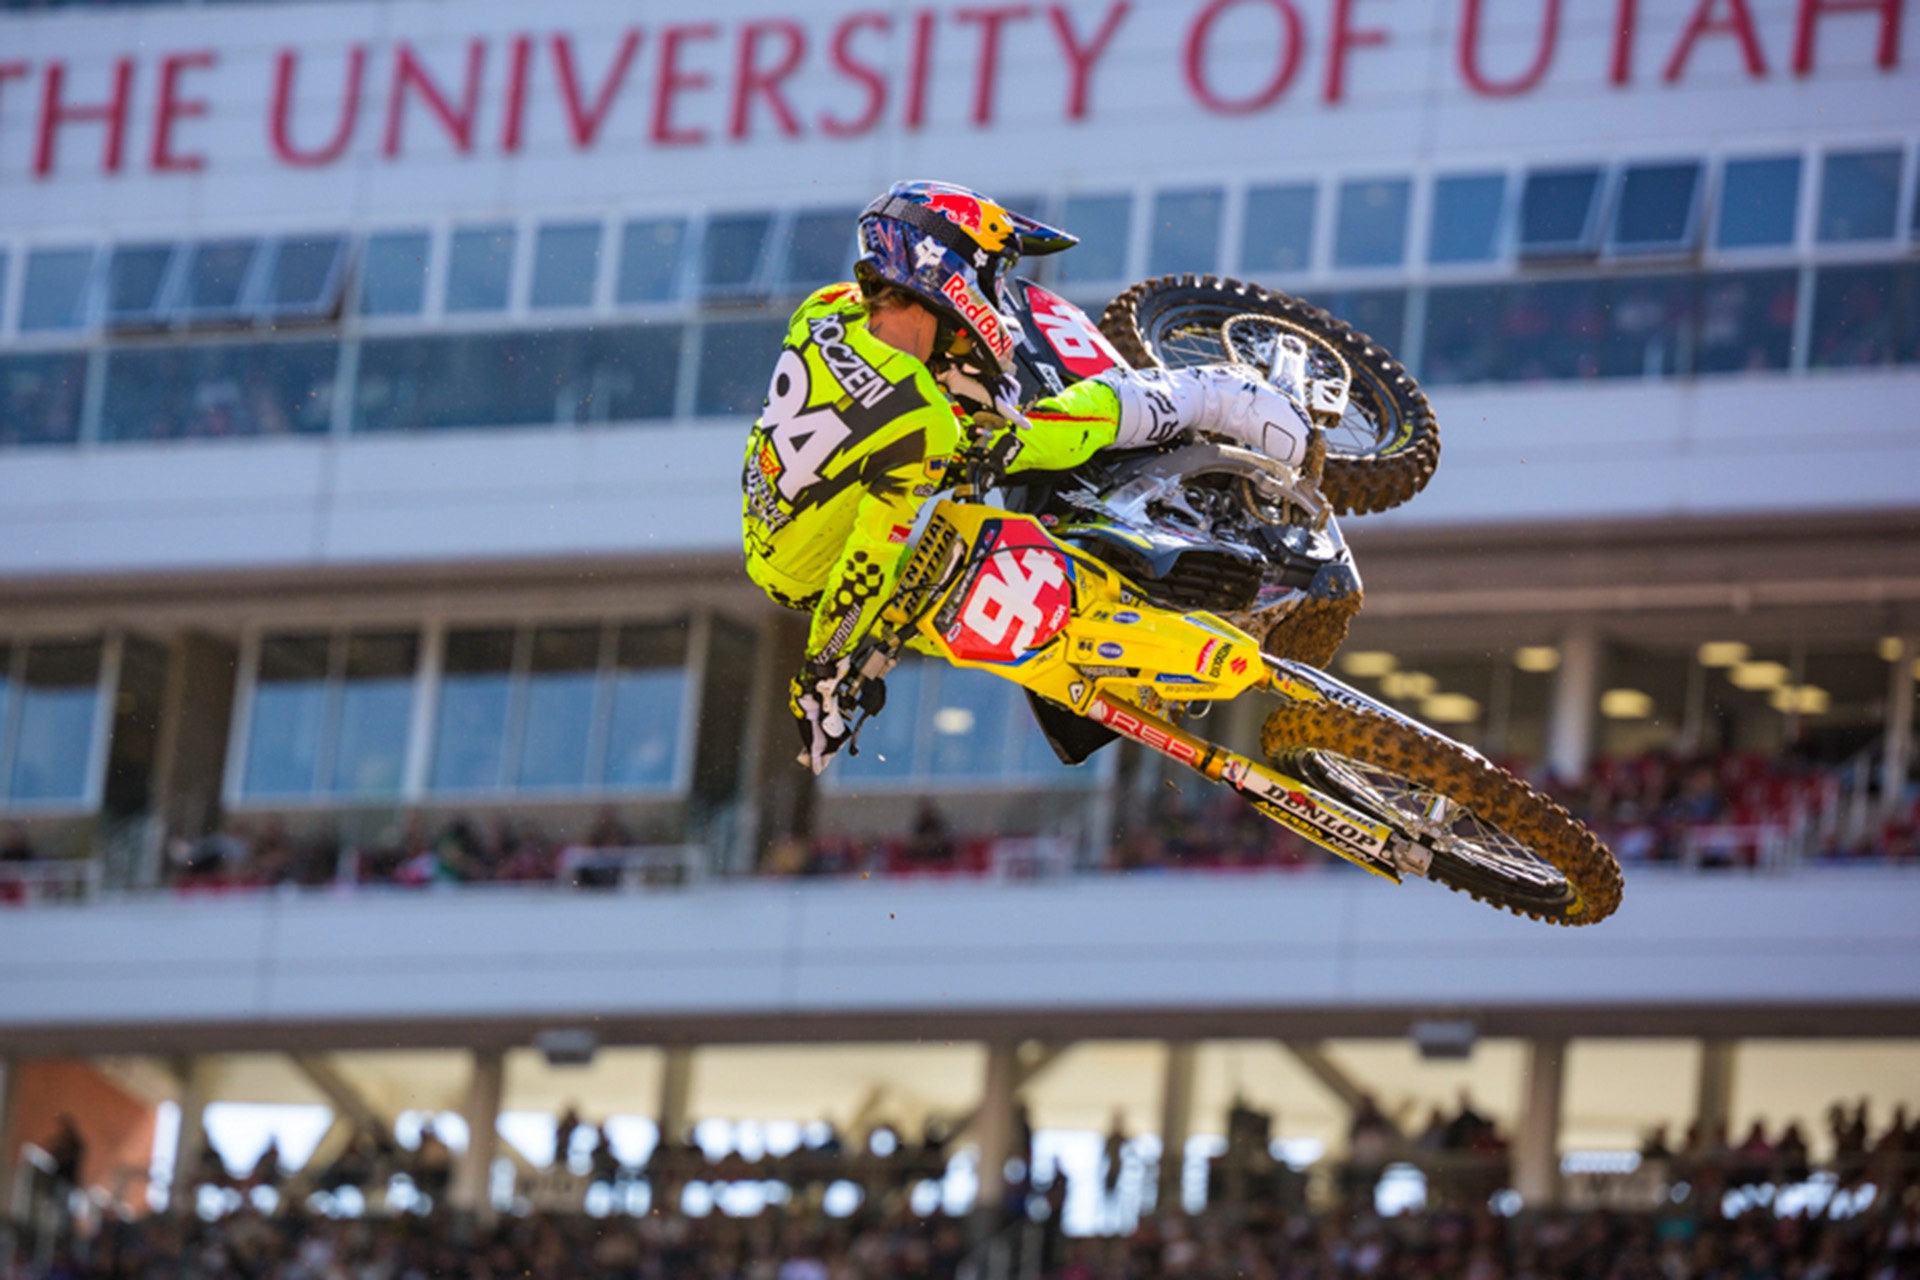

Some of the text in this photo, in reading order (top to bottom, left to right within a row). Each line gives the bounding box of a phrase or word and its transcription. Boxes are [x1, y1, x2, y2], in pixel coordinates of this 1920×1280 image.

[267, 2, 1129, 168] UNIVERSITY
[1182, 0, 1390, 117] OF
[807, 314, 896, 410] ROCZEN
[941, 272, 1014, 359] Red Bull
[761, 349, 853, 501] 94
[963, 540, 1065, 660] 94
[1263, 783, 1378, 846] DUNLOP
